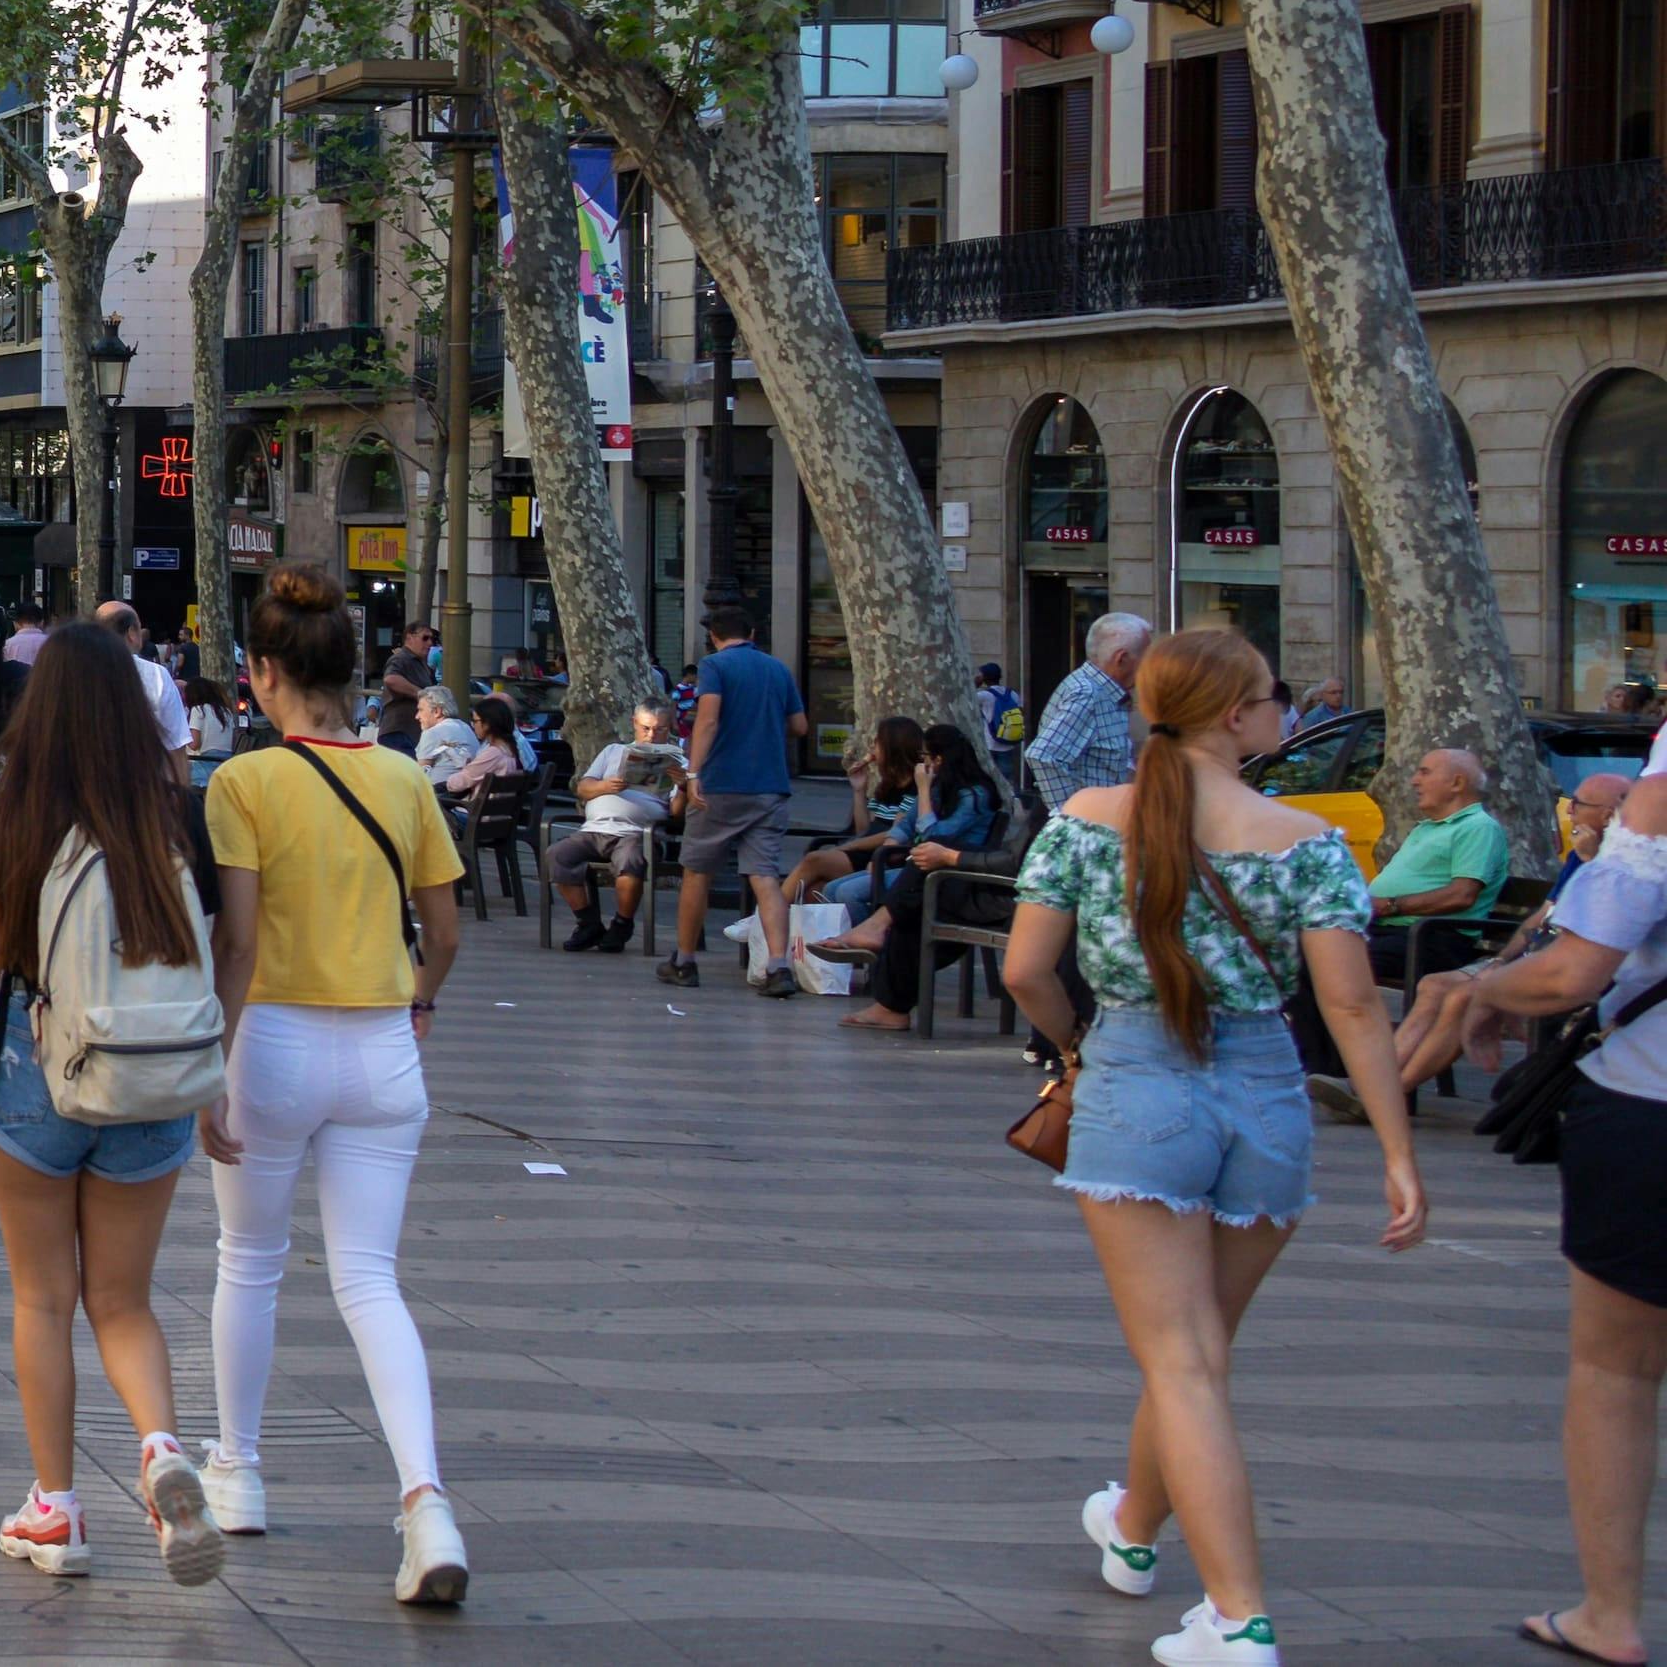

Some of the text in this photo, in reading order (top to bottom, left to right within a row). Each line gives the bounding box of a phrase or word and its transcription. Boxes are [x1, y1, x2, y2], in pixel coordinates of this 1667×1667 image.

[1046, 528, 1088, 540] CASAS
[1204, 531, 1254, 543] CASAS
[136, 550, 149, 566] P
